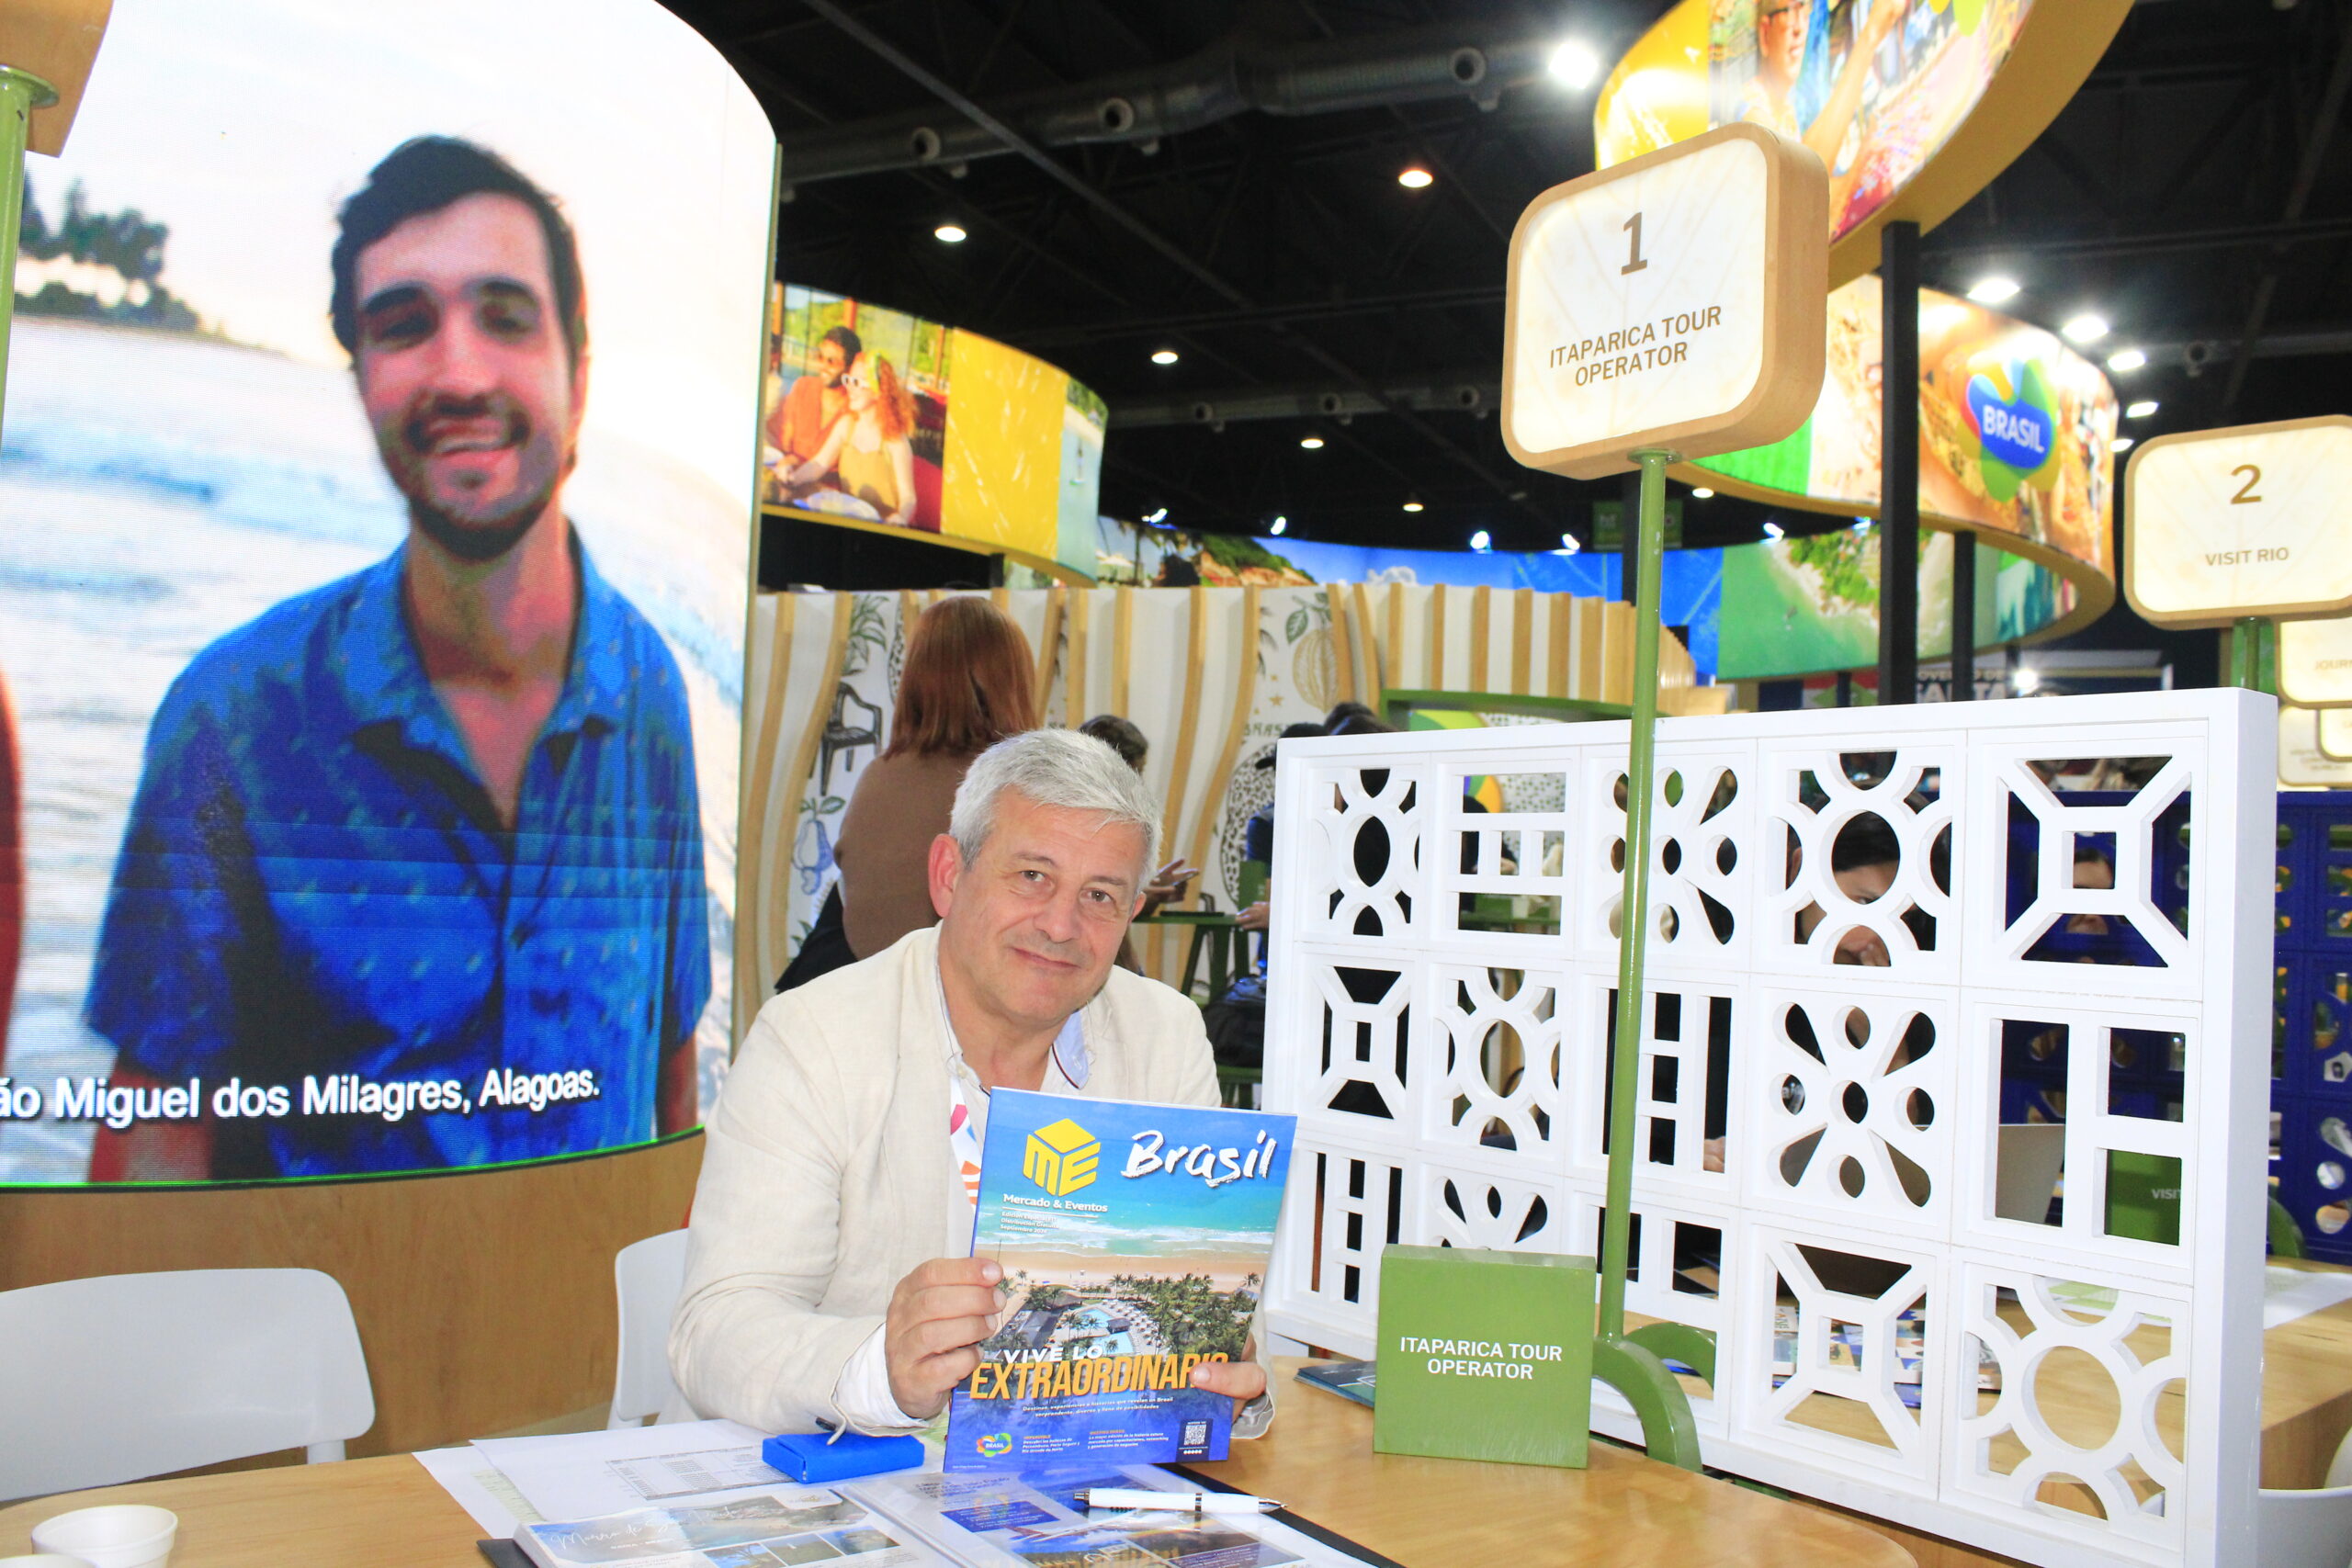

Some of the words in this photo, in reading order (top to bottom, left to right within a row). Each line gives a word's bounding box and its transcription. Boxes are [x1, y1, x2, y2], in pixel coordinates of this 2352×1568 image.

[1621, 211, 1648, 276] 1
[1550, 322, 1656, 368] ITAPARICA
[1660, 305, 1722, 338] TOUR
[1575, 342, 1688, 387] OPERATOR
[1983, 404, 2044, 453] BRASIL
[2230, 464, 2262, 505] 2
[2205, 550, 2252, 566] VISIT
[2257, 547, 2289, 562] RIO
[55, 1077, 200, 1129] Miguel
[212, 1077, 290, 1118] dos
[302, 1074, 470, 1122] Milagres,
[479, 1067, 600, 1111] Alagoas.
[1023, 1134, 1101, 1197] ME
[1121, 1130, 1277, 1188] Brasil
[1002, 1193, 1050, 1208] Mercado
[1053, 1199, 1062, 1209] &
[1065, 1201, 1108, 1213] Eventos
[1002, 1348, 1063, 1364] VIVE
[1072, 1345, 1103, 1360] LO
[1400, 1337, 1504, 1359] ITAPARICA
[1508, 1343, 1563, 1362] TOUR
[1427, 1358, 1533, 1381] OPERATOR
[969, 1352, 1229, 1400] EXTRAORDINAR
